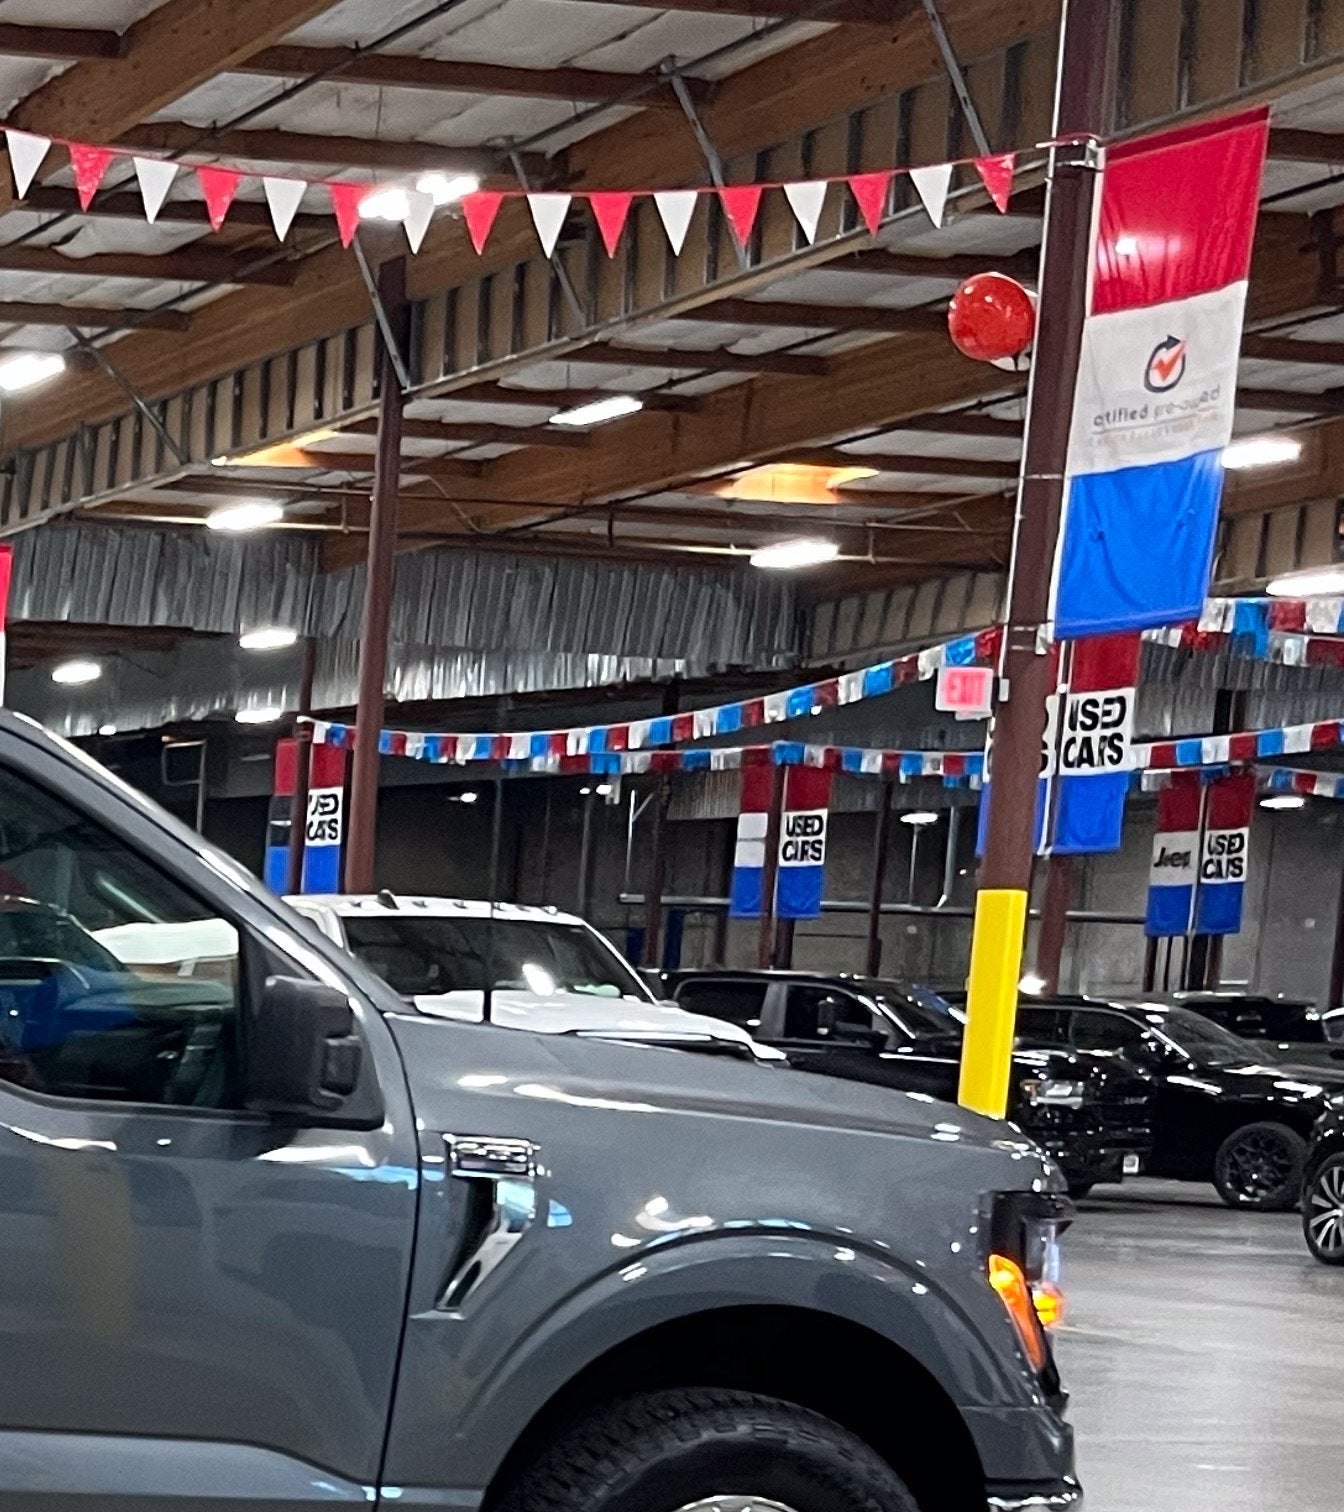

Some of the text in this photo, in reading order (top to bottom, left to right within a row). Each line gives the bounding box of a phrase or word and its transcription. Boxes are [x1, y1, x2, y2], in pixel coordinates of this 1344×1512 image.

[1068, 695, 1127, 732] USED
[1063, 732, 1124, 769] CARS
[308, 793, 340, 816] ED
[786, 814, 824, 838] USED
